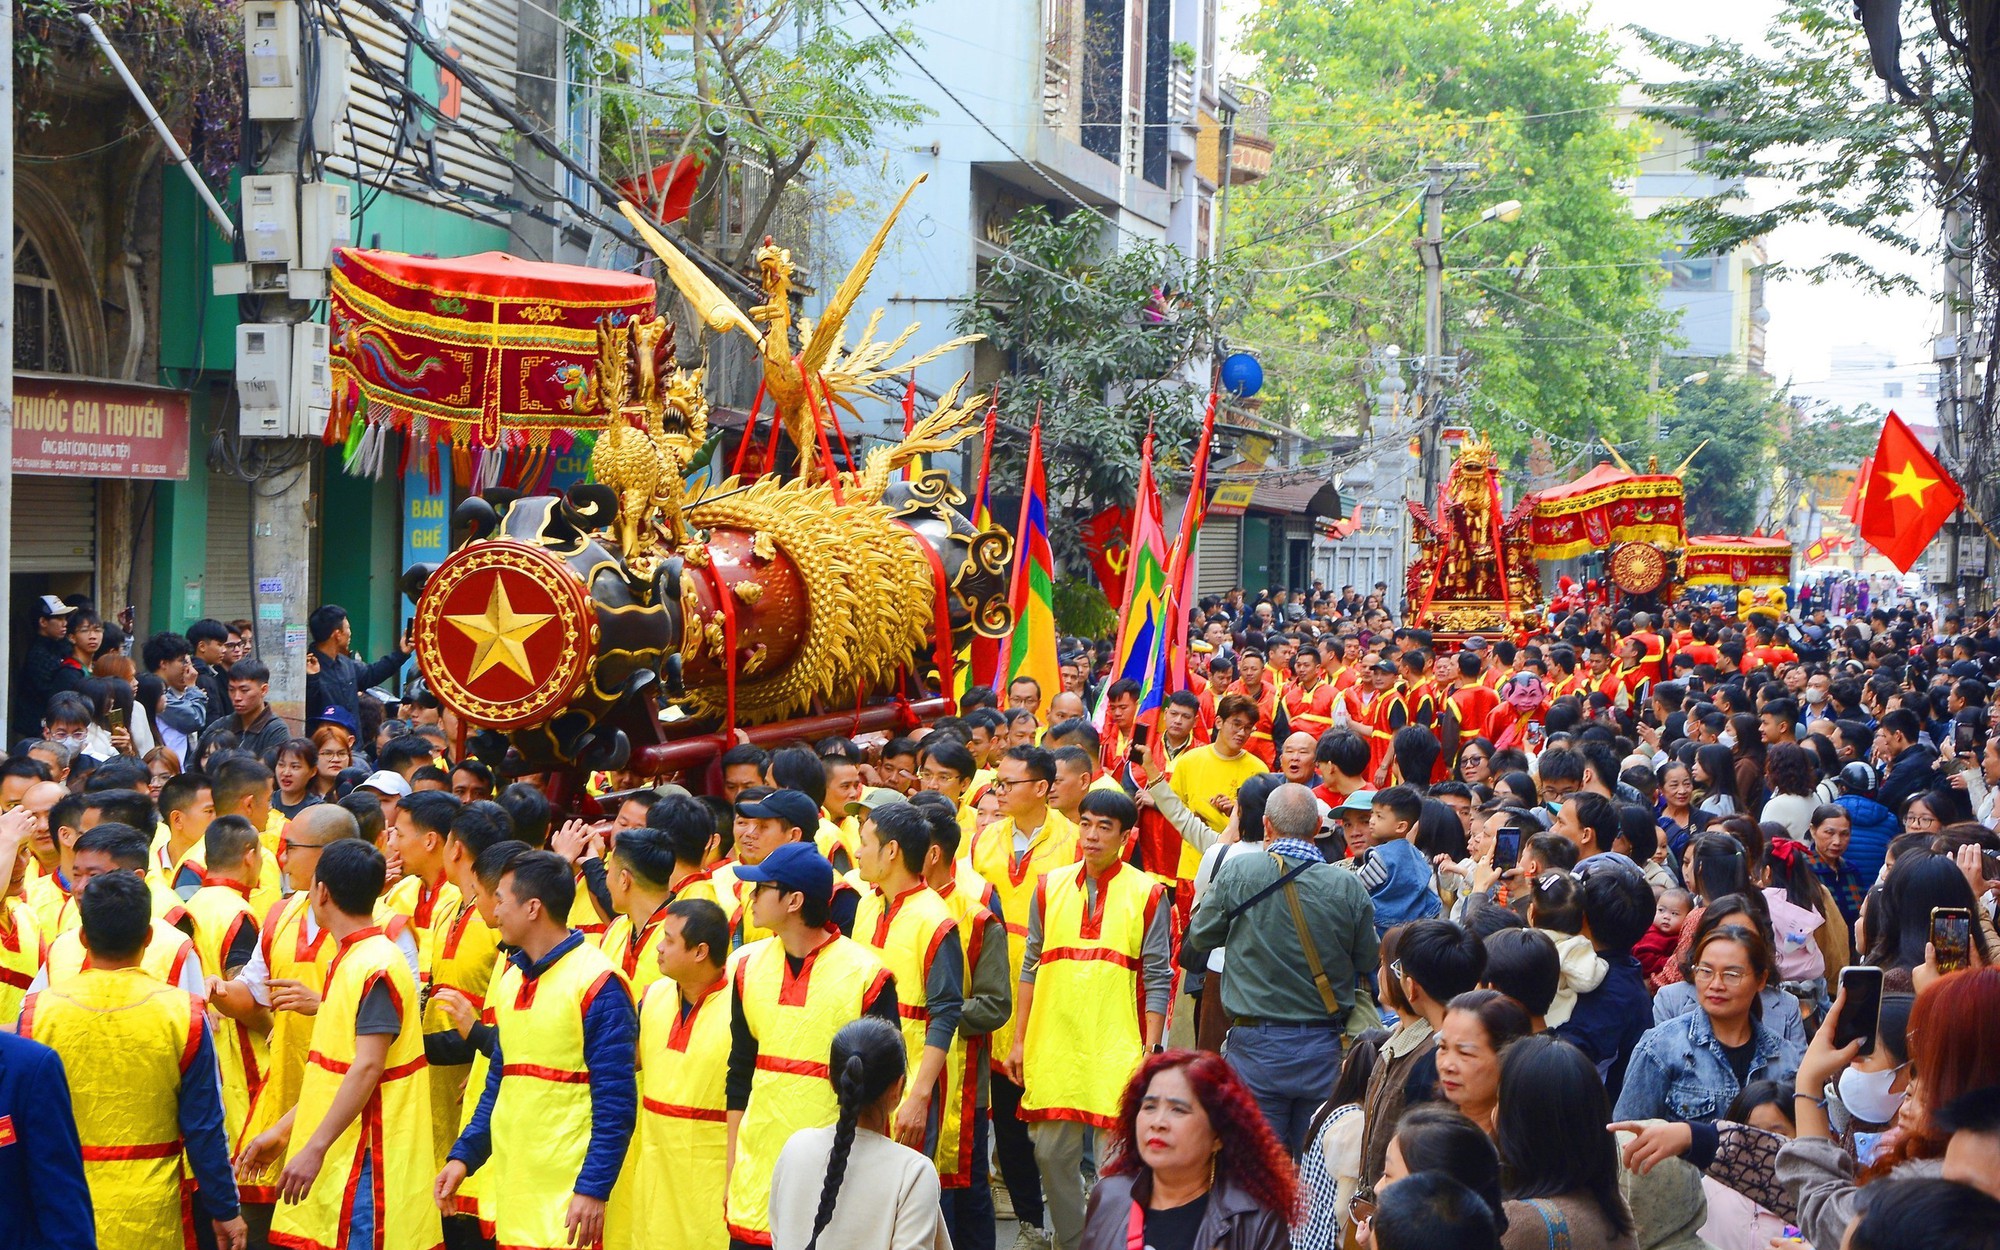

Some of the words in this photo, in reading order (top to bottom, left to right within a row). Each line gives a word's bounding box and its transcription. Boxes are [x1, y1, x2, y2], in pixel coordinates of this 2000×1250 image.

[13, 389, 69, 433] THUỐC
[72, 400, 100, 434] GIA
[412, 524, 444, 548] GHẾ
